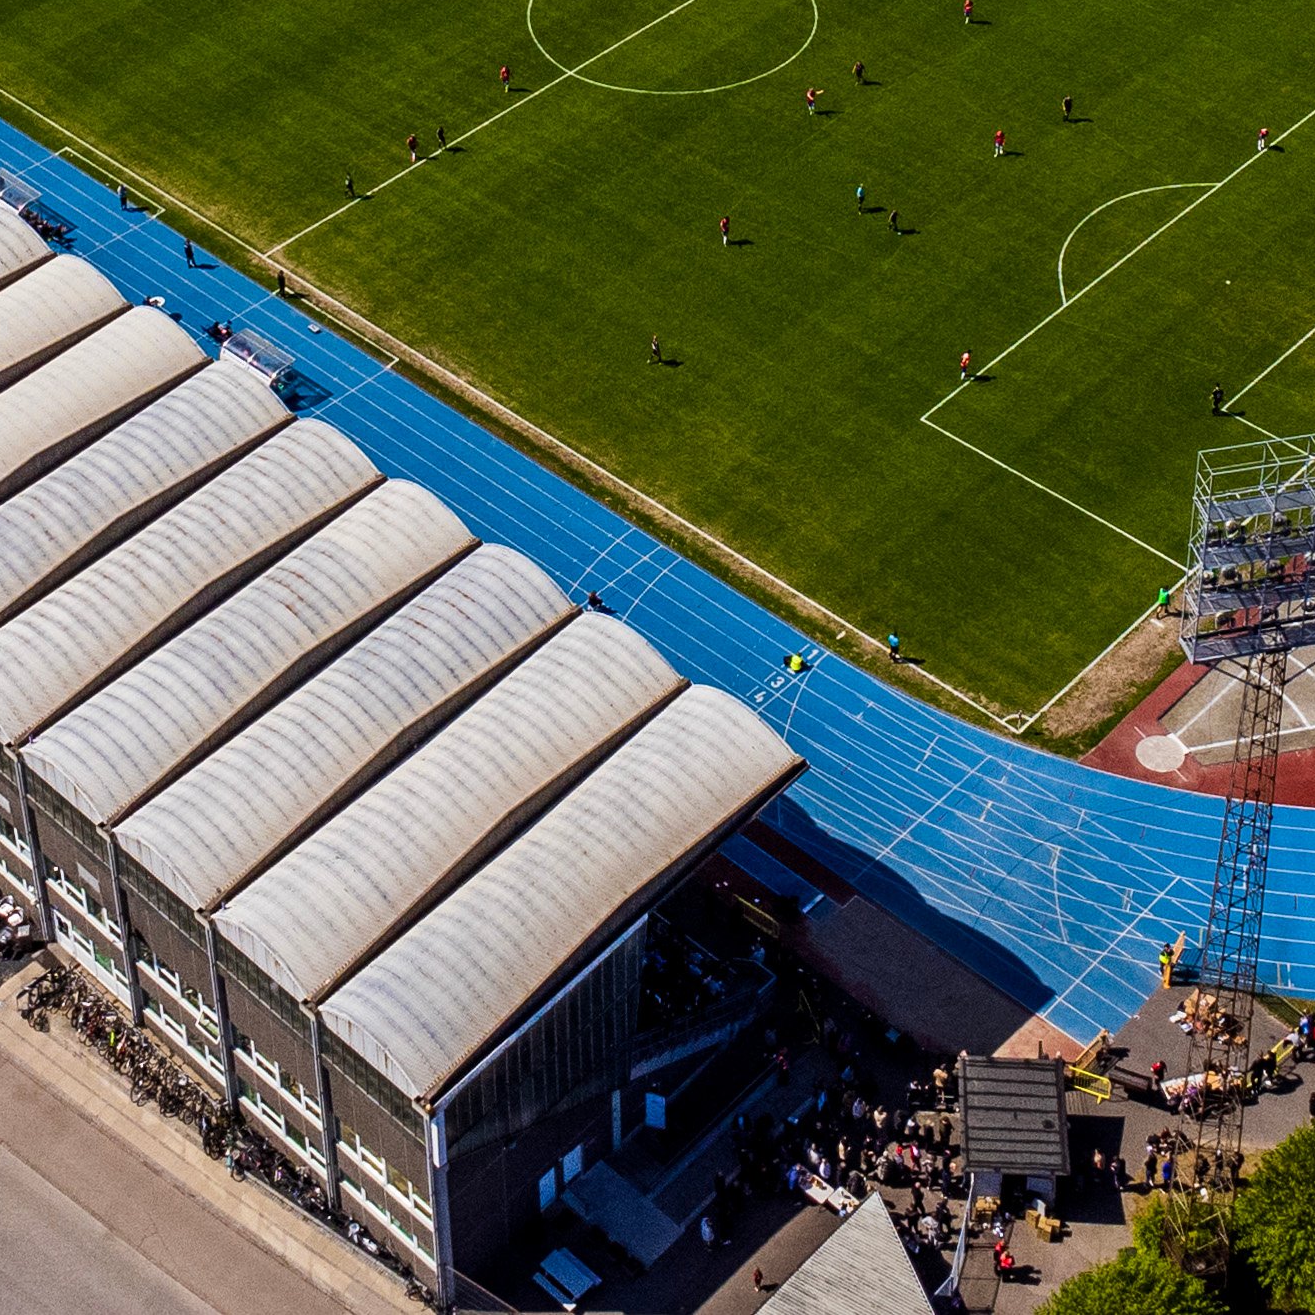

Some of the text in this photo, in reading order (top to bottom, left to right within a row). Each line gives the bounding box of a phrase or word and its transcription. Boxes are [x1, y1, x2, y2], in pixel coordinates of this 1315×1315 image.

[806, 649, 820, 661] 1
[770, 676, 785, 689] 3
[753, 691, 767, 703] 4
